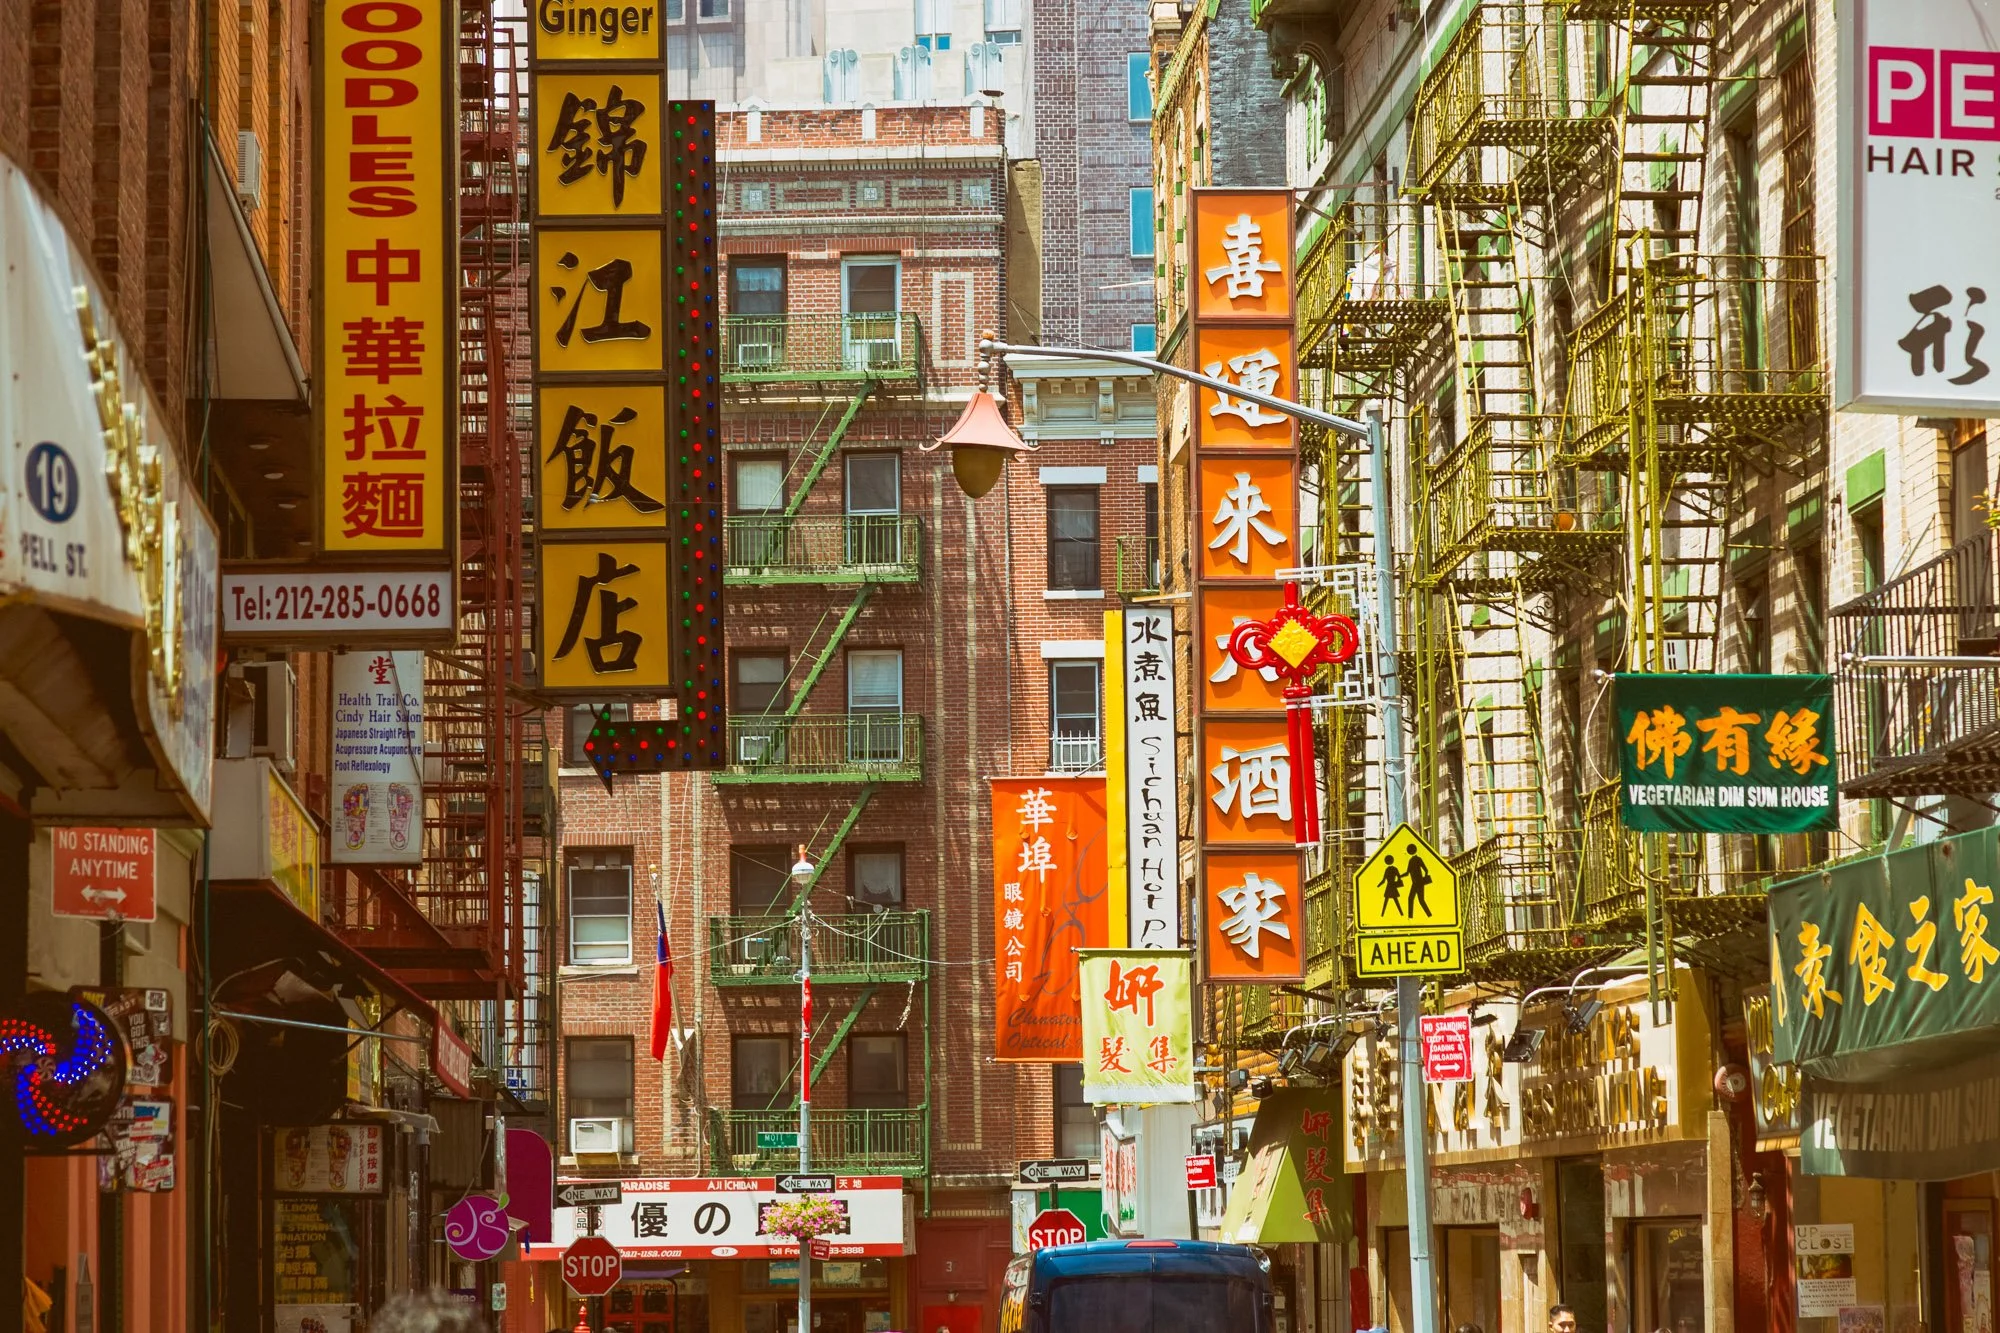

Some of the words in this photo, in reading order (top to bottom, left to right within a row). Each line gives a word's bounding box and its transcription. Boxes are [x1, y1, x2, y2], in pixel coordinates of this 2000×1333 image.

[540, 0, 654, 43] Ginger
[1867, 146, 1975, 176] HAIR
[1898, 284, 1990, 386] 形
[341, 239, 426, 539] 中華拉麵
[546, 85, 666, 674] 錦江飯店
[36, 451, 69, 514] 19
[20, 532, 58, 573] PELL
[66, 541, 88, 578] ST.
[368, 655, 395, 685] 堂
[338, 693, 371, 706] Health
[376, 693, 399, 706] Trail
[403, 693, 419, 707] Co.
[335, 709, 364, 726] Cindy
[369, 709, 391, 722] Hair
[395, 709, 422, 723] Salon
[335, 728, 368, 740] Japanese
[369, 728, 396, 741] Straight
[1626, 704, 1830, 779] 佛有緣
[335, 744, 378, 756] Acupressure
[335, 760, 350, 771] Foot
[351, 760, 391, 774] Reflexology
[1141, 736, 1163, 849] Sichuan
[1629, 784, 1715, 807] VEGETARIAN
[1719, 785, 1745, 807] DIM
[1748, 785, 1778, 807] SUM
[1781, 785, 1829, 807] HOUSE
[59, 831, 77, 850] NO
[83, 832, 149, 855] STANDING
[1016, 786, 1058, 885] 華埠
[69, 858, 139, 880] ANYTIME
[1141, 858, 1163, 909] Hot
[1003, 882, 1025, 983] 眼鏡公司
[1370, 940, 1451, 966] AHEAD
[1424, 1022, 1433, 1032] NO
[1435, 1021, 1467, 1031] STANDING
[1426, 1034, 1445, 1043] EXCEPT
[1446, 1033, 1466, 1042] TRUCKS
[1431, 1044, 1455, 1052] LOADING
[1431, 1053, 1464, 1061] UNLOADING
[1813, 1092, 1924, 1153] VEGETARIAN
[1929, 1086, 1960, 1151] DIM
[1029, 1167, 1049, 1177] ONE
[1061, 1166, 1082, 1176] WAY
[566, 1190, 586, 1200] ONE
[594, 1188, 613, 1199] WAY
[707, 1180, 723, 1190] AJI
[725, 1180, 758, 1191] ICHIBAN
[785, 1180, 801, 1188] ONE
[810, 1179, 828, 1188] WAY
[1031, 1228, 1083, 1251] STOP
[1797, 1226, 1818, 1238] UP
[618, 1248, 682, 1258] ban-usa.com
[769, 1247, 783, 1255] Toll
[1798, 1237, 1853, 1250] CLOSE
[566, 1255, 618, 1278] STOP
[945, 1261, 953, 1272] 3
